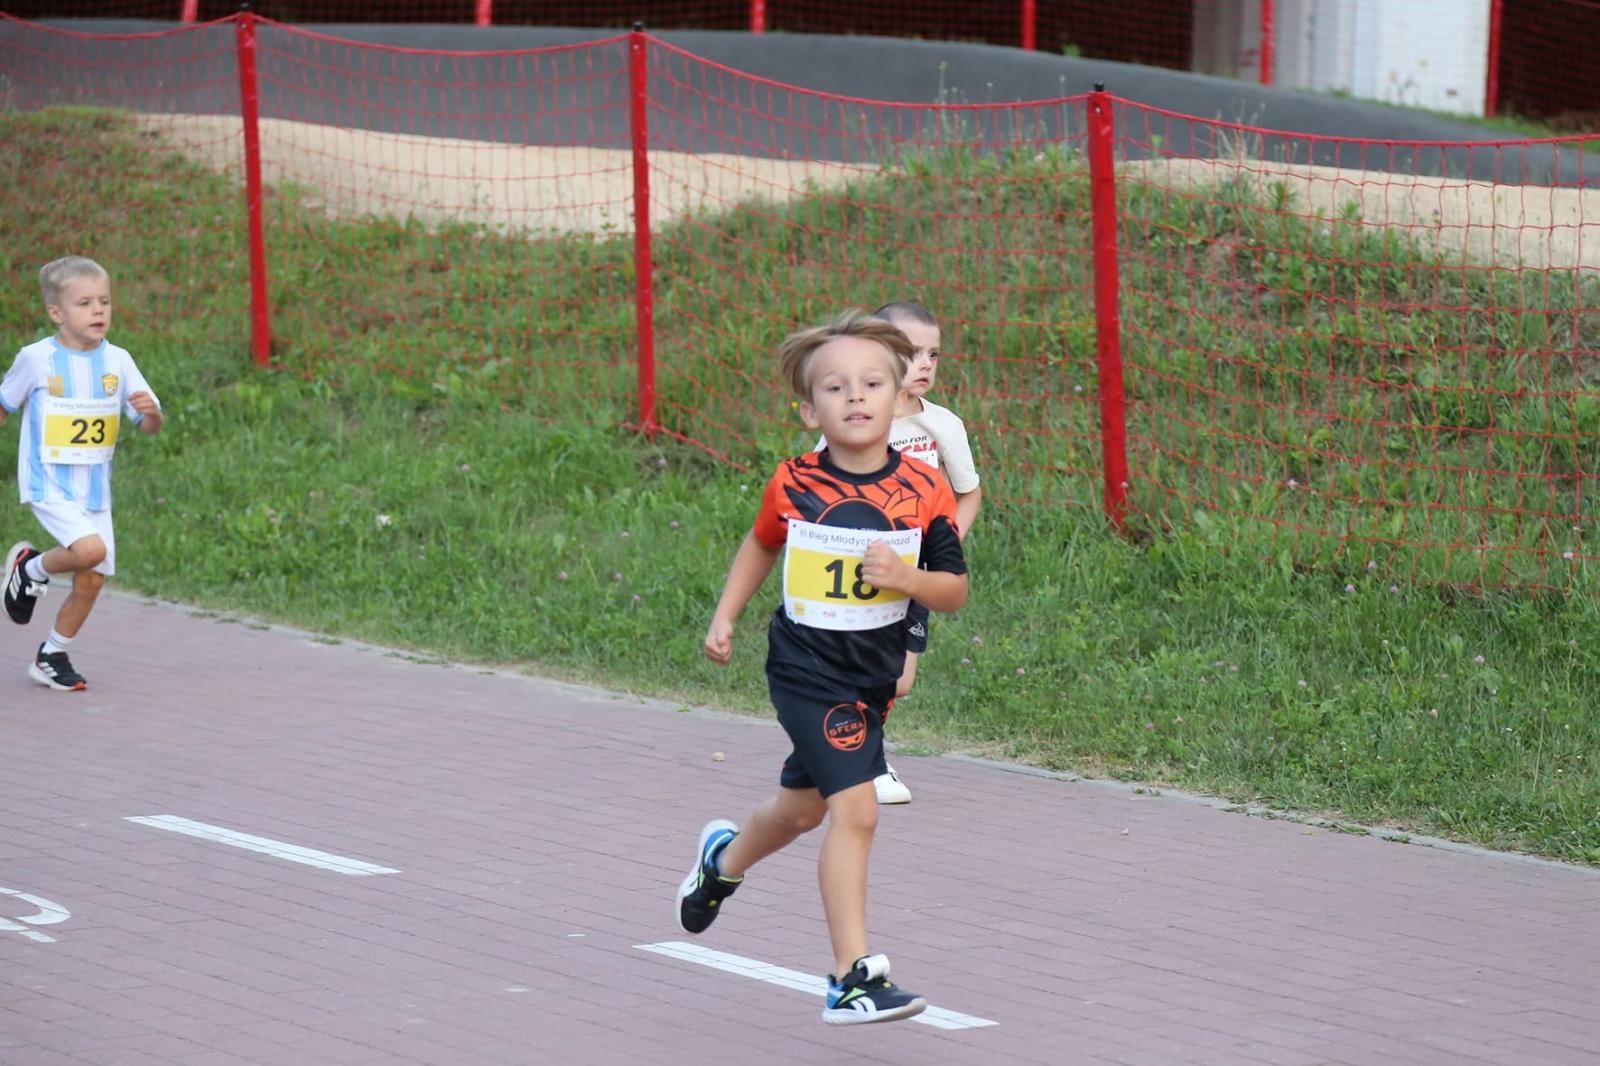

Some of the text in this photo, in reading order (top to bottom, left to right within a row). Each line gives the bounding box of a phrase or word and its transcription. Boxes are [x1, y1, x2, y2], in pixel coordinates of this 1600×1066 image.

[70, 419, 105, 444] 23
[808, 530, 829, 544] Bieg
[878, 535, 911, 546] wiazd
